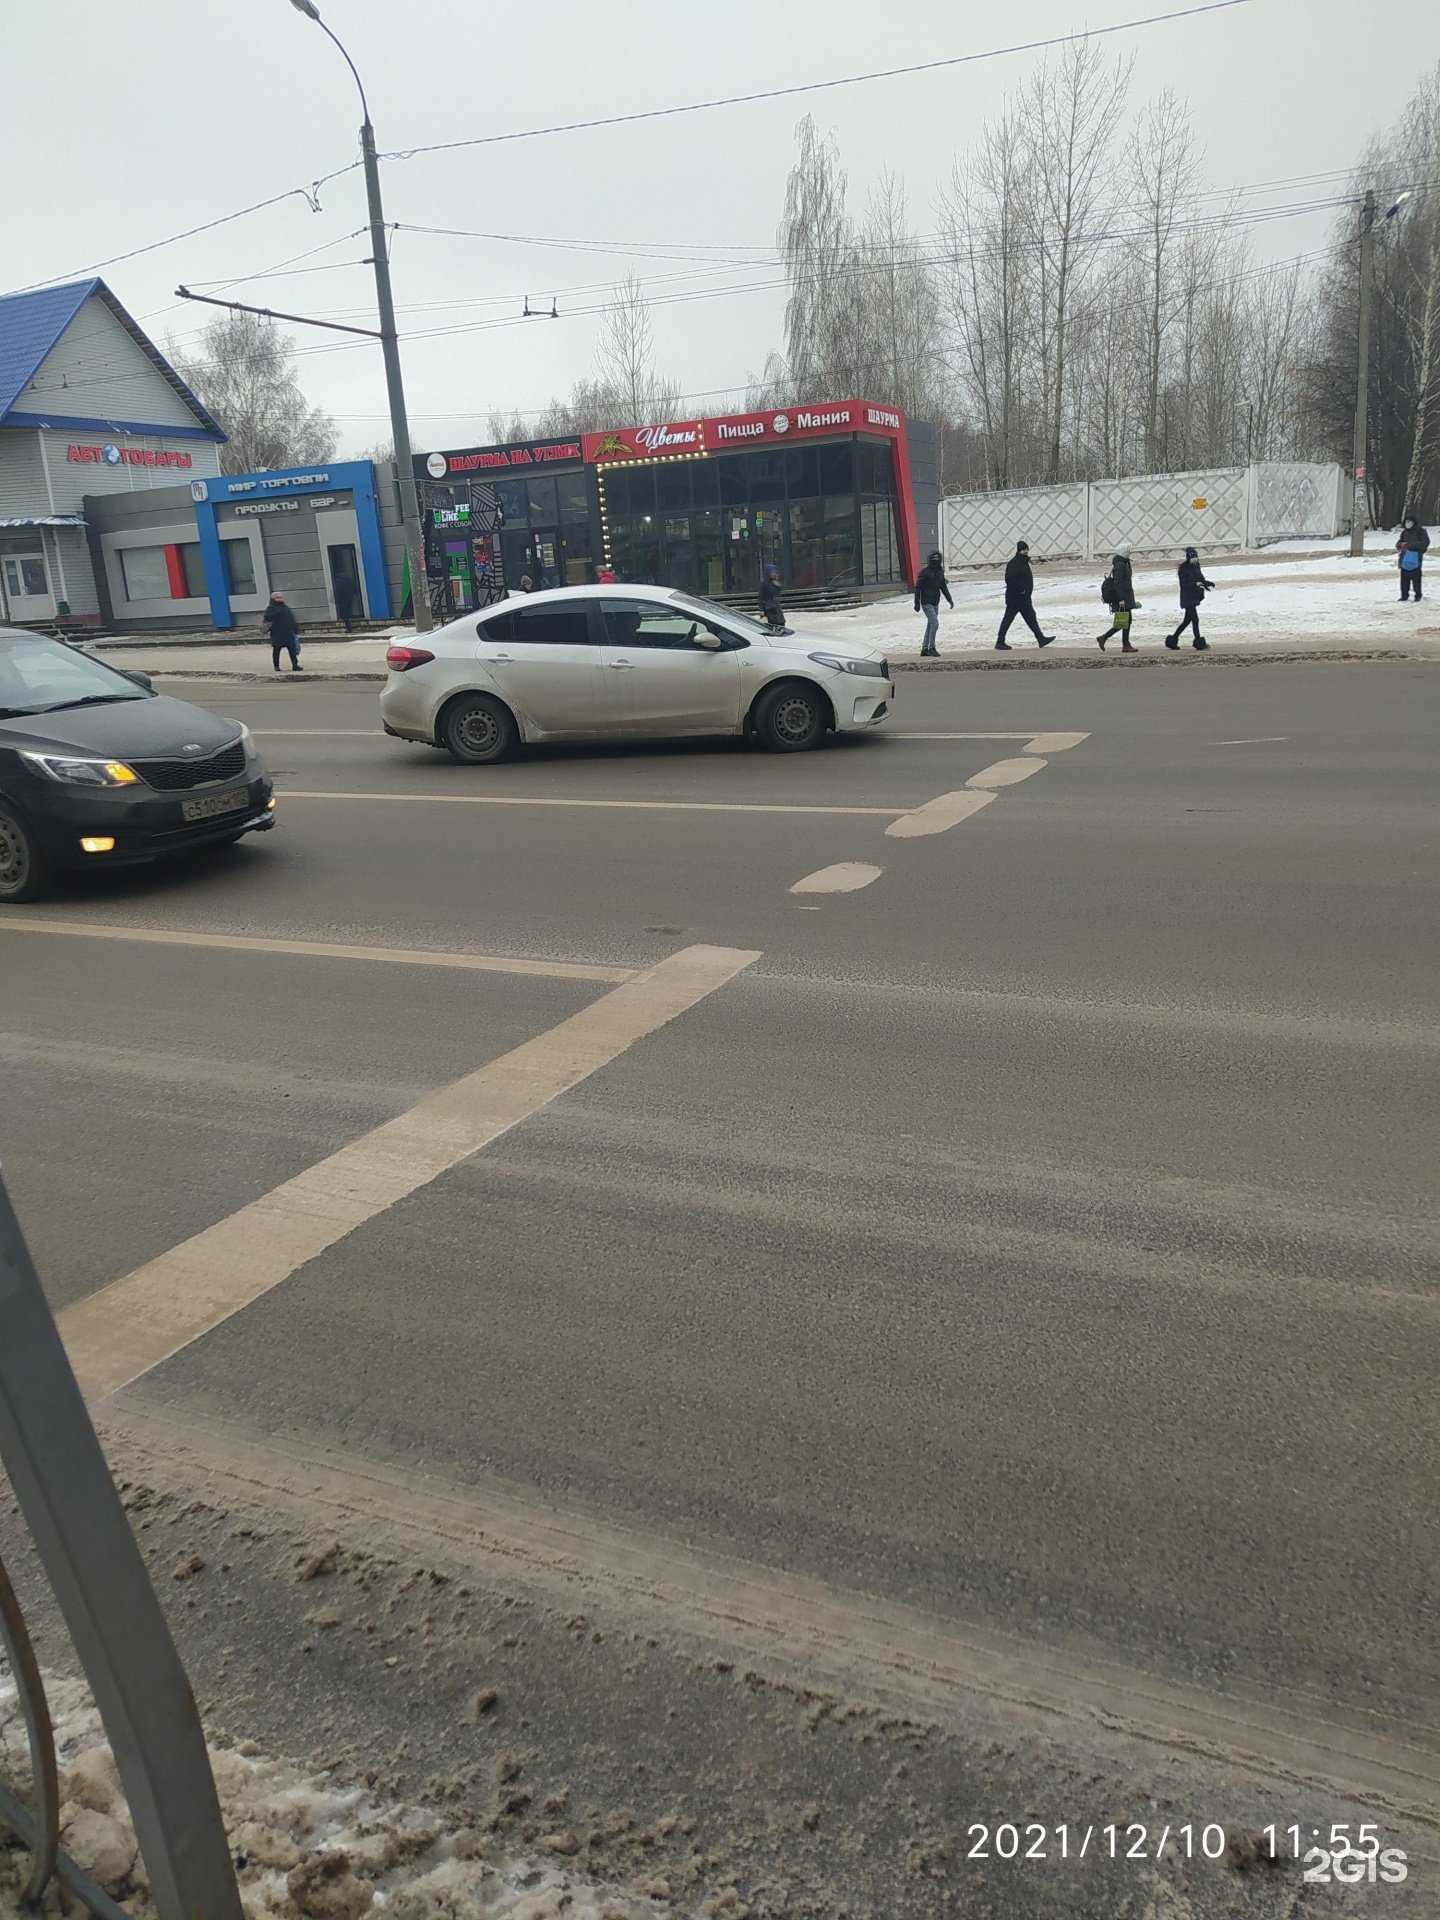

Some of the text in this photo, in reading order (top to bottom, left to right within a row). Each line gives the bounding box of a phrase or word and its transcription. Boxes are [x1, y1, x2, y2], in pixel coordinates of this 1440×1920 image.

[718, 422, 764, 439] Пицца
[797, 411, 850, 428] Мания
[868, 408, 900, 428] ШАУРМА
[635, 425, 696, 453] Цветы
[449, 451, 510, 471] ШАУРМА
[511, 449, 532, 465] НА
[228, 473, 329, 492] МИР ТОРГОВЛИ
[235, 501, 299, 515] ПРОДУКТЫ
